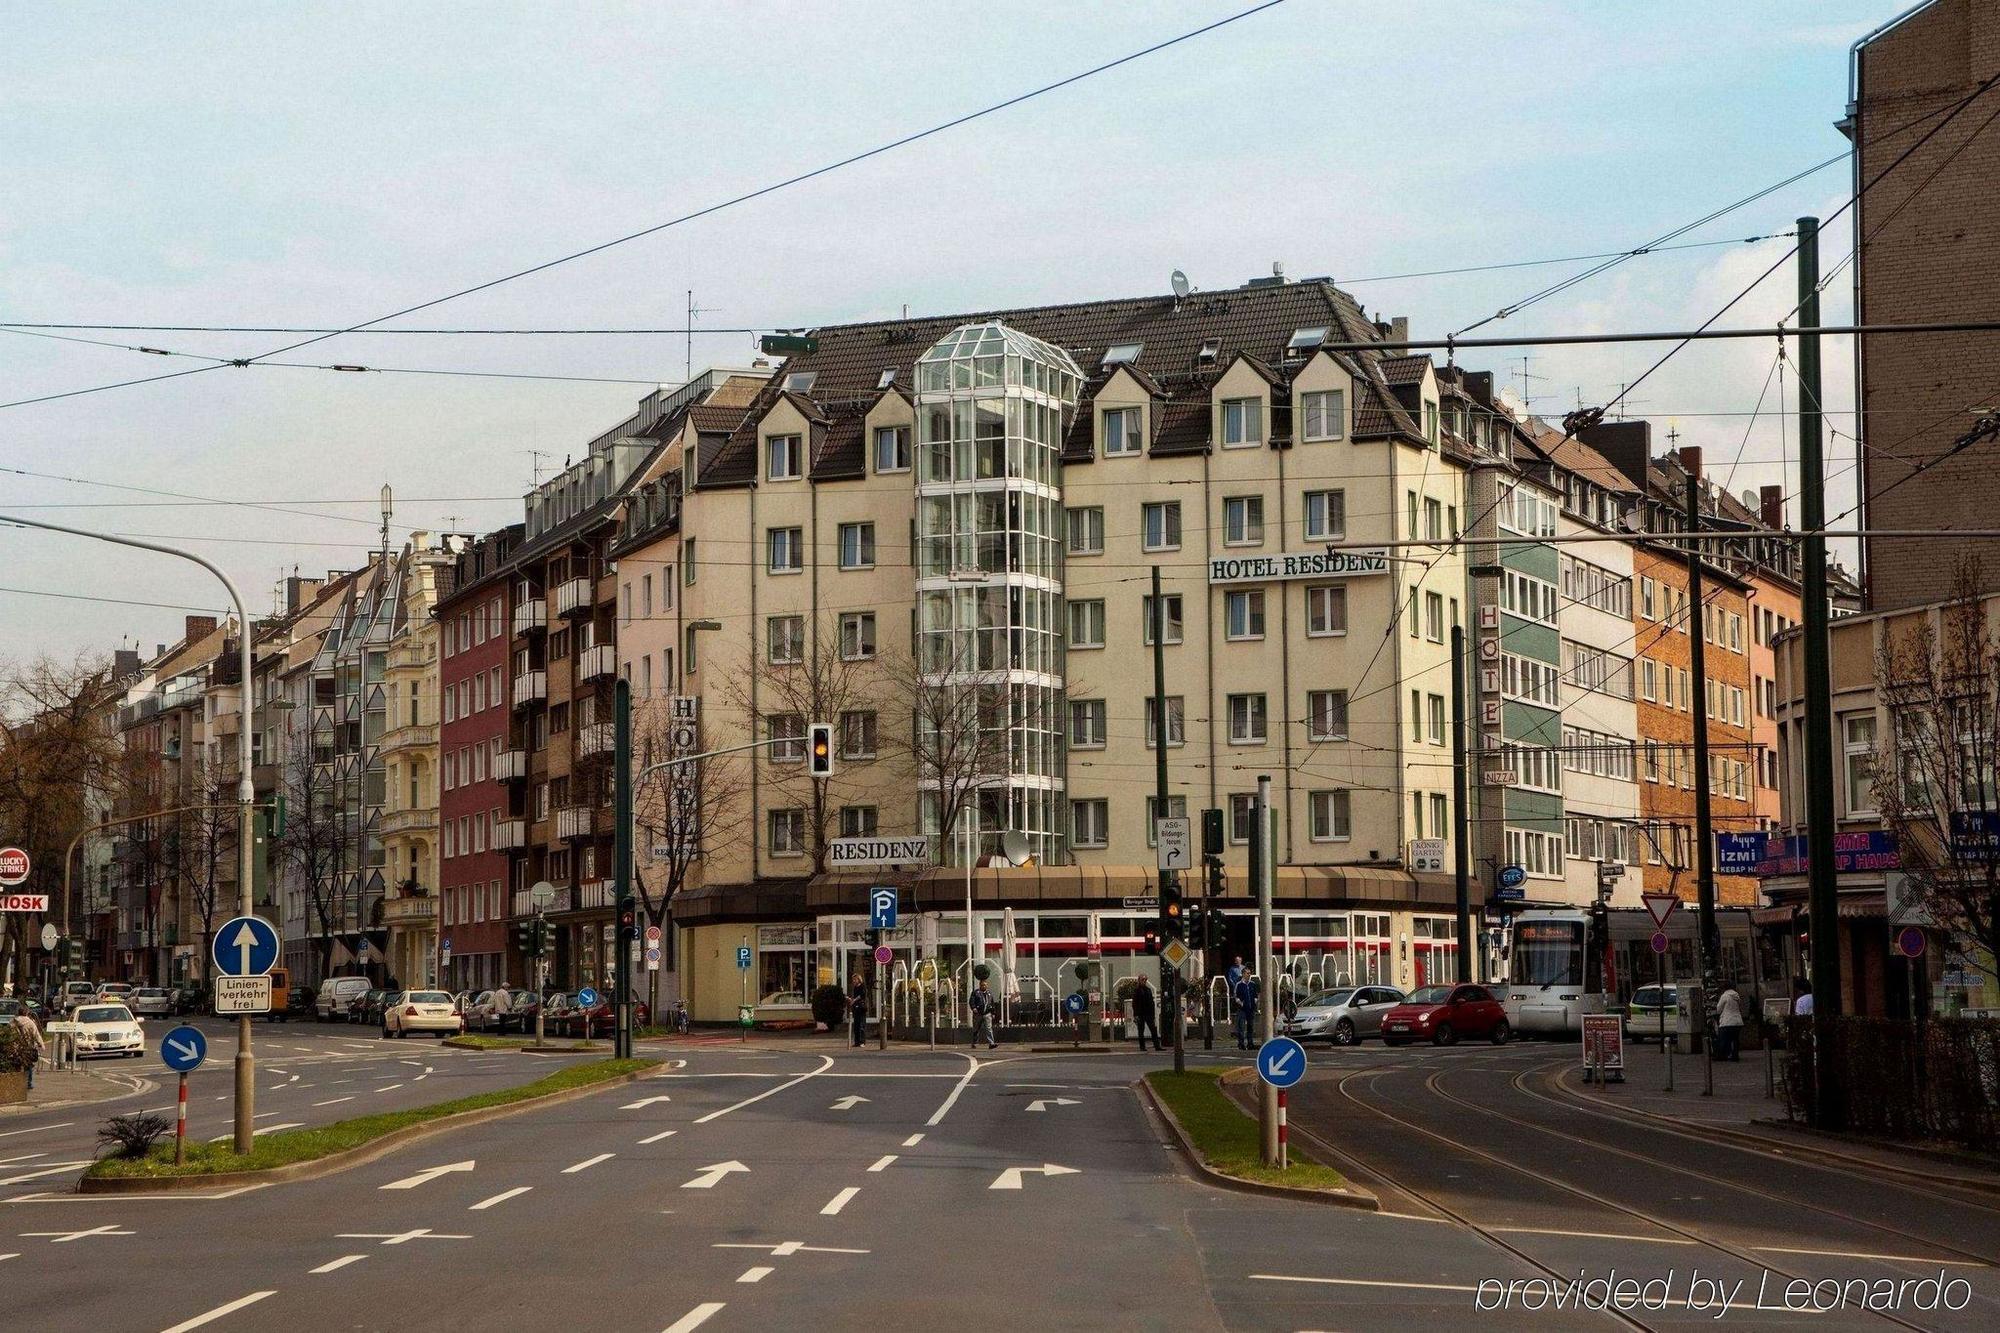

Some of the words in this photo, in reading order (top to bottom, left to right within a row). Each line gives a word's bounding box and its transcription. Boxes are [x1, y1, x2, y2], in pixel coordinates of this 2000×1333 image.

[1212, 558, 1278, 580] HOTEL
[1284, 551, 1386, 576] RESIDENZ
[1482, 607, 1499, 755] HOTEL
[1486, 771, 1516, 784] NIZZA
[831, 841, 926, 861] RESIDENZ
[0, 857, 25, 865] LUCKY
[0, 865, 25, 873] STRIKE
[1720, 866, 1746, 874] KEBAP
[876, 897, 892, 918] P
[226, 980, 263, 989] Linien-
[222, 990, 267, 999] verkehr
[233, 1000, 254, 1009] frei
